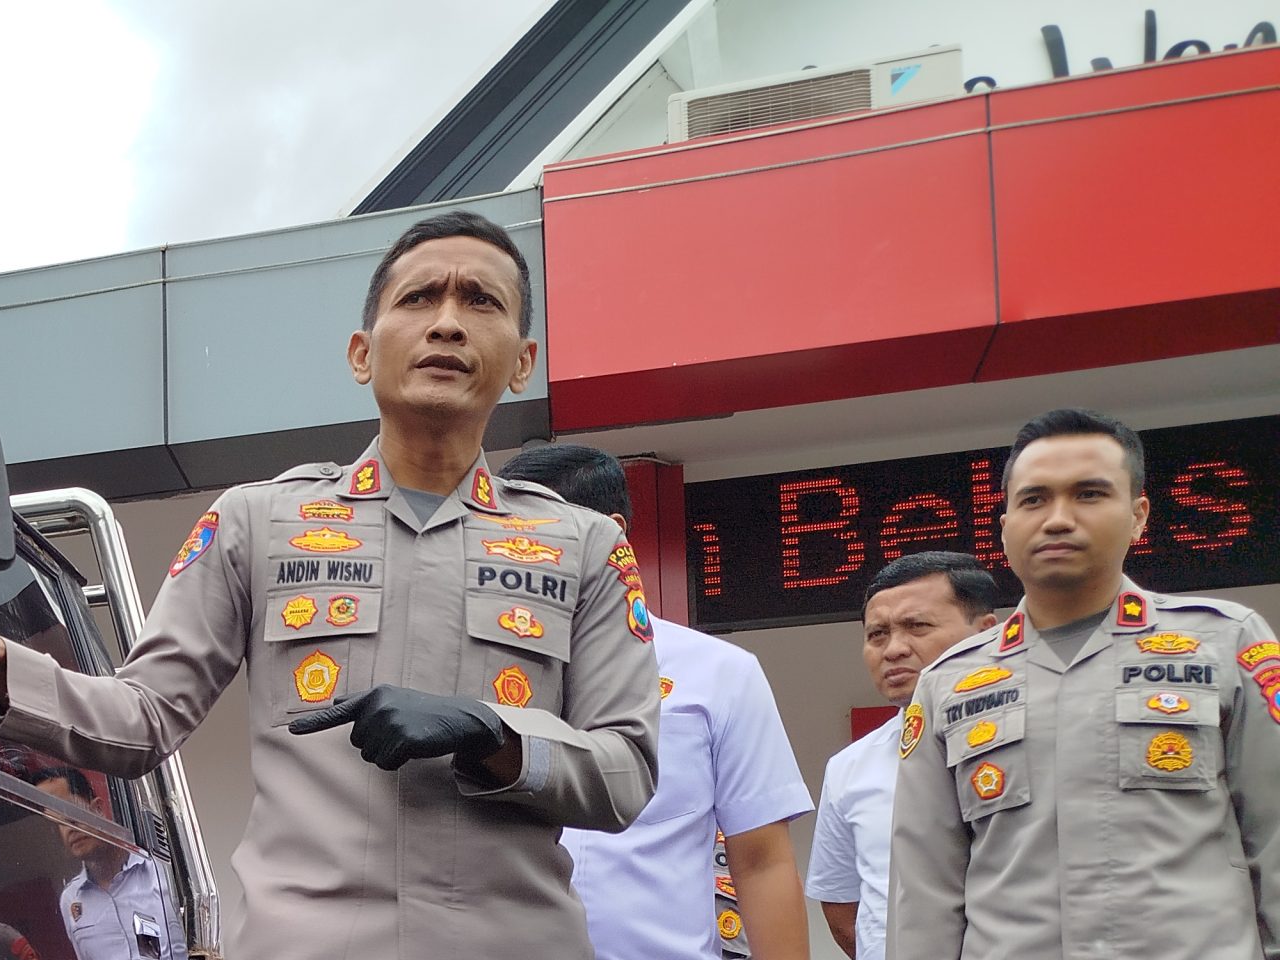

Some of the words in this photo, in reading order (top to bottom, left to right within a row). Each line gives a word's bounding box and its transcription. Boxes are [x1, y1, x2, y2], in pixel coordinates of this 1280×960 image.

[277, 560, 320, 584] ANDIN
[327, 560, 373, 583] WISNU
[478, 566, 567, 602] POLRI
[1122, 664, 1213, 684] POLRI
